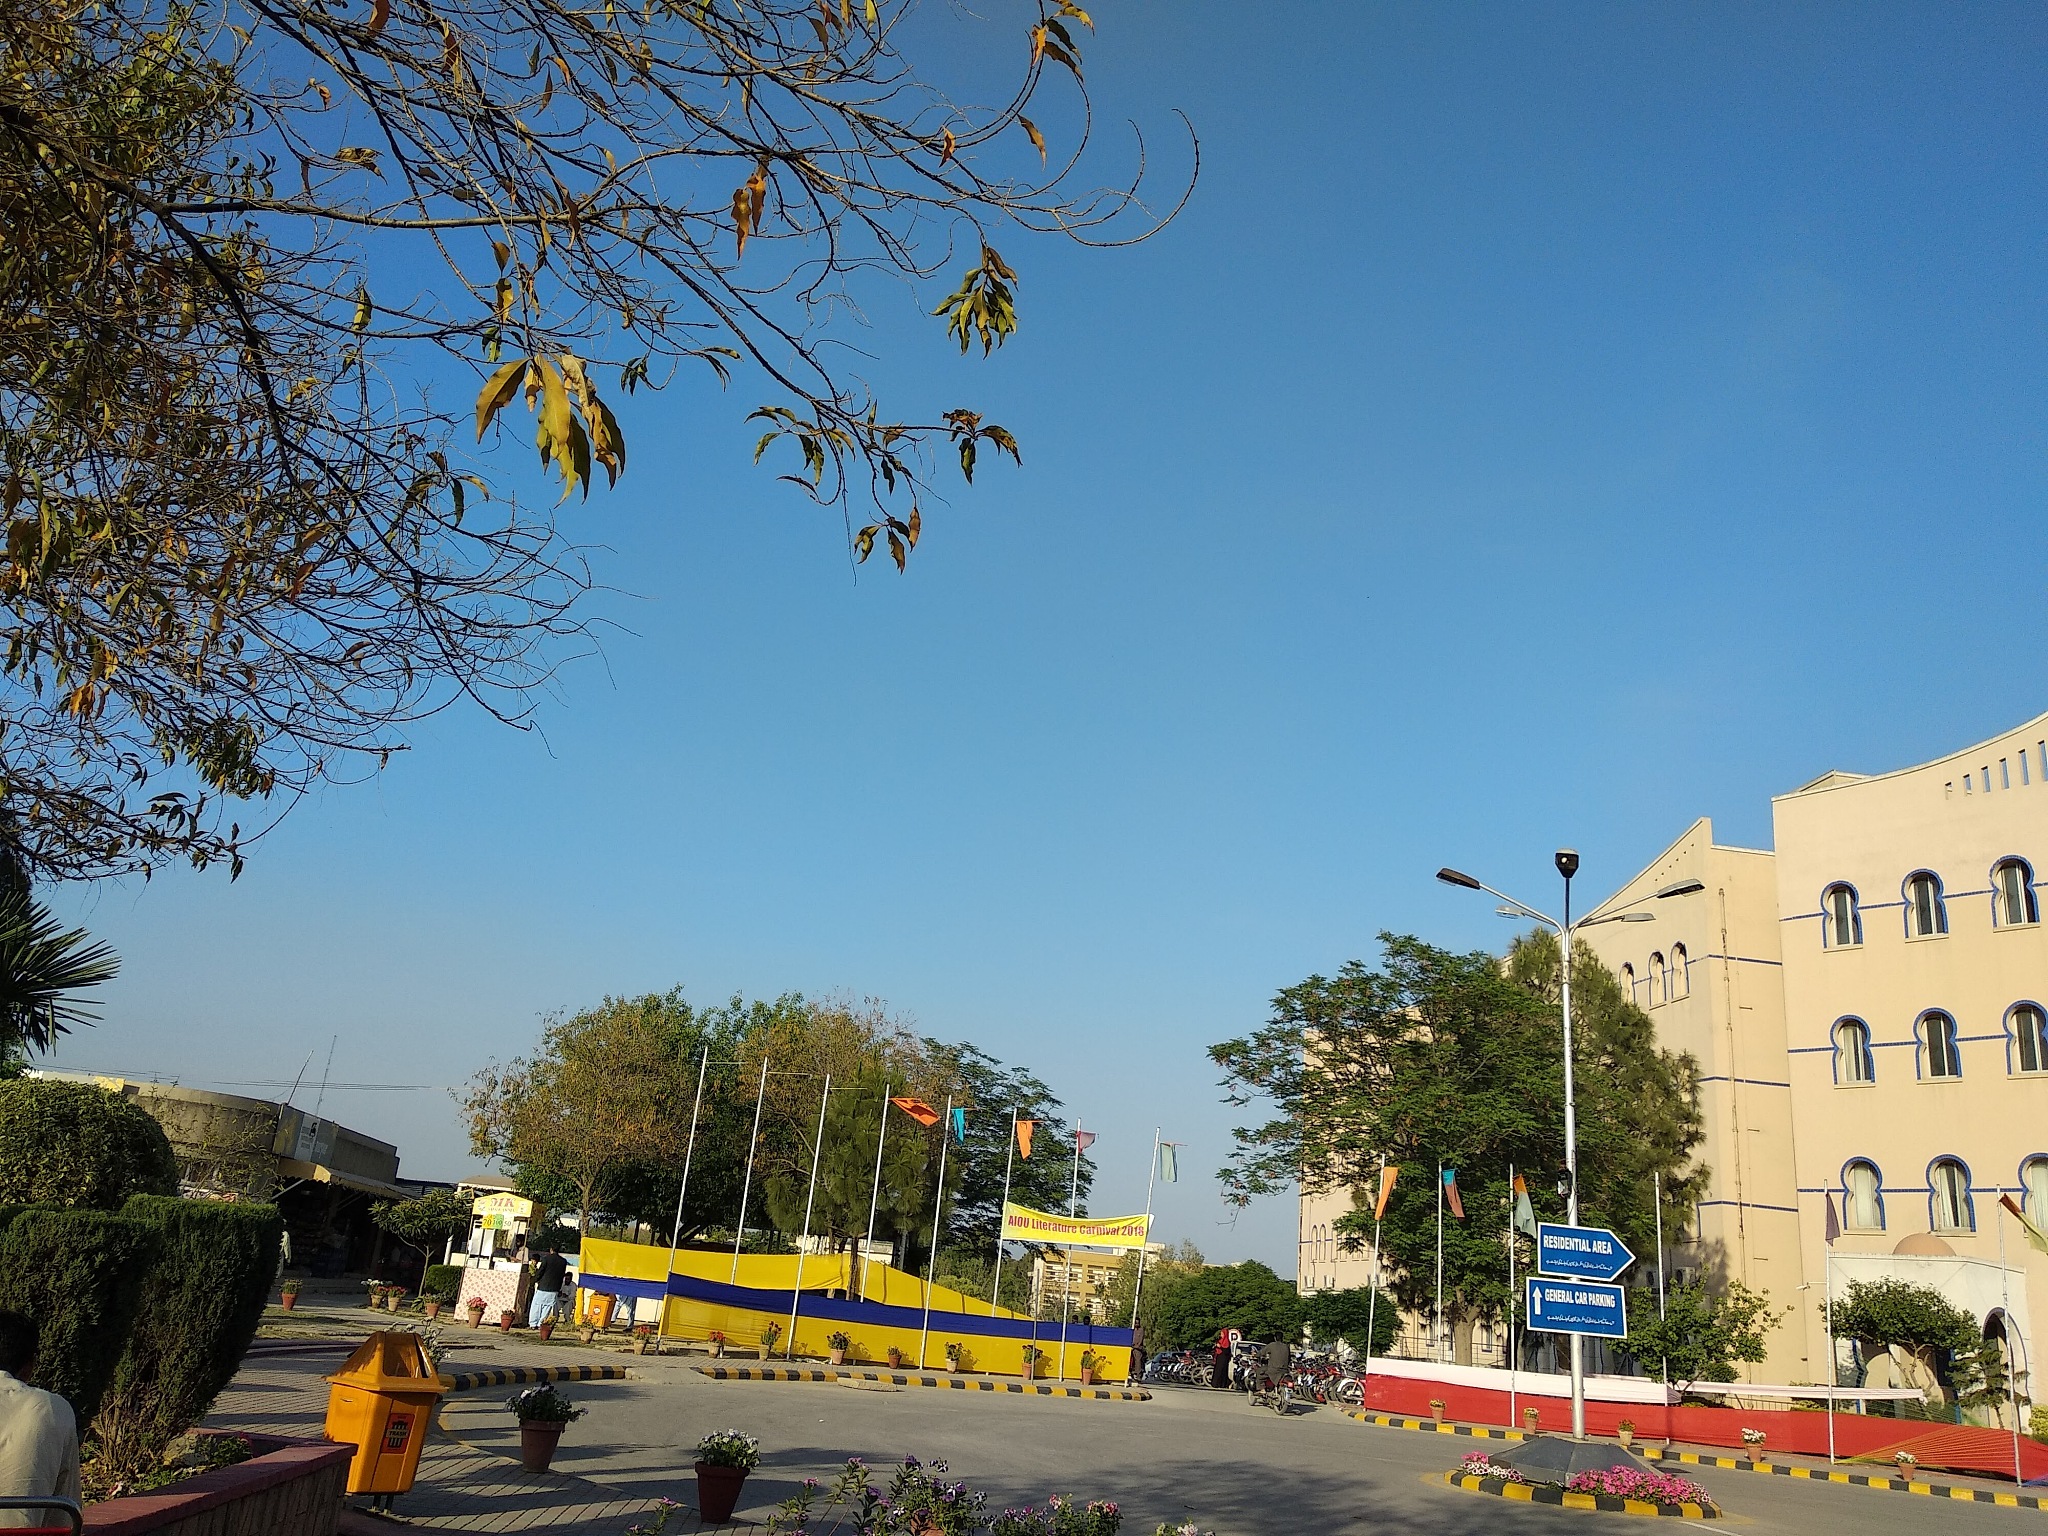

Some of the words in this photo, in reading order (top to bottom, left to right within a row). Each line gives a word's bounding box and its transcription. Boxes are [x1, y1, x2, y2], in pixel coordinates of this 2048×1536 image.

[1008, 1215, 1030, 1229] AIOU
[1031, 1218, 1077, 1234] Literature
[1079, 1225, 1120, 1236] Carnival
[1121, 1225, 1145, 1237] 2018
[1543, 1235, 1592, 1253] RESIDENTIAL
[1592, 1240, 1613, 1255] AREA
[1544, 1288, 1574, 1304] GENERAL
[1574, 1291, 1588, 1305] CAR
[1588, 1293, 1616, 1308] PARKING
